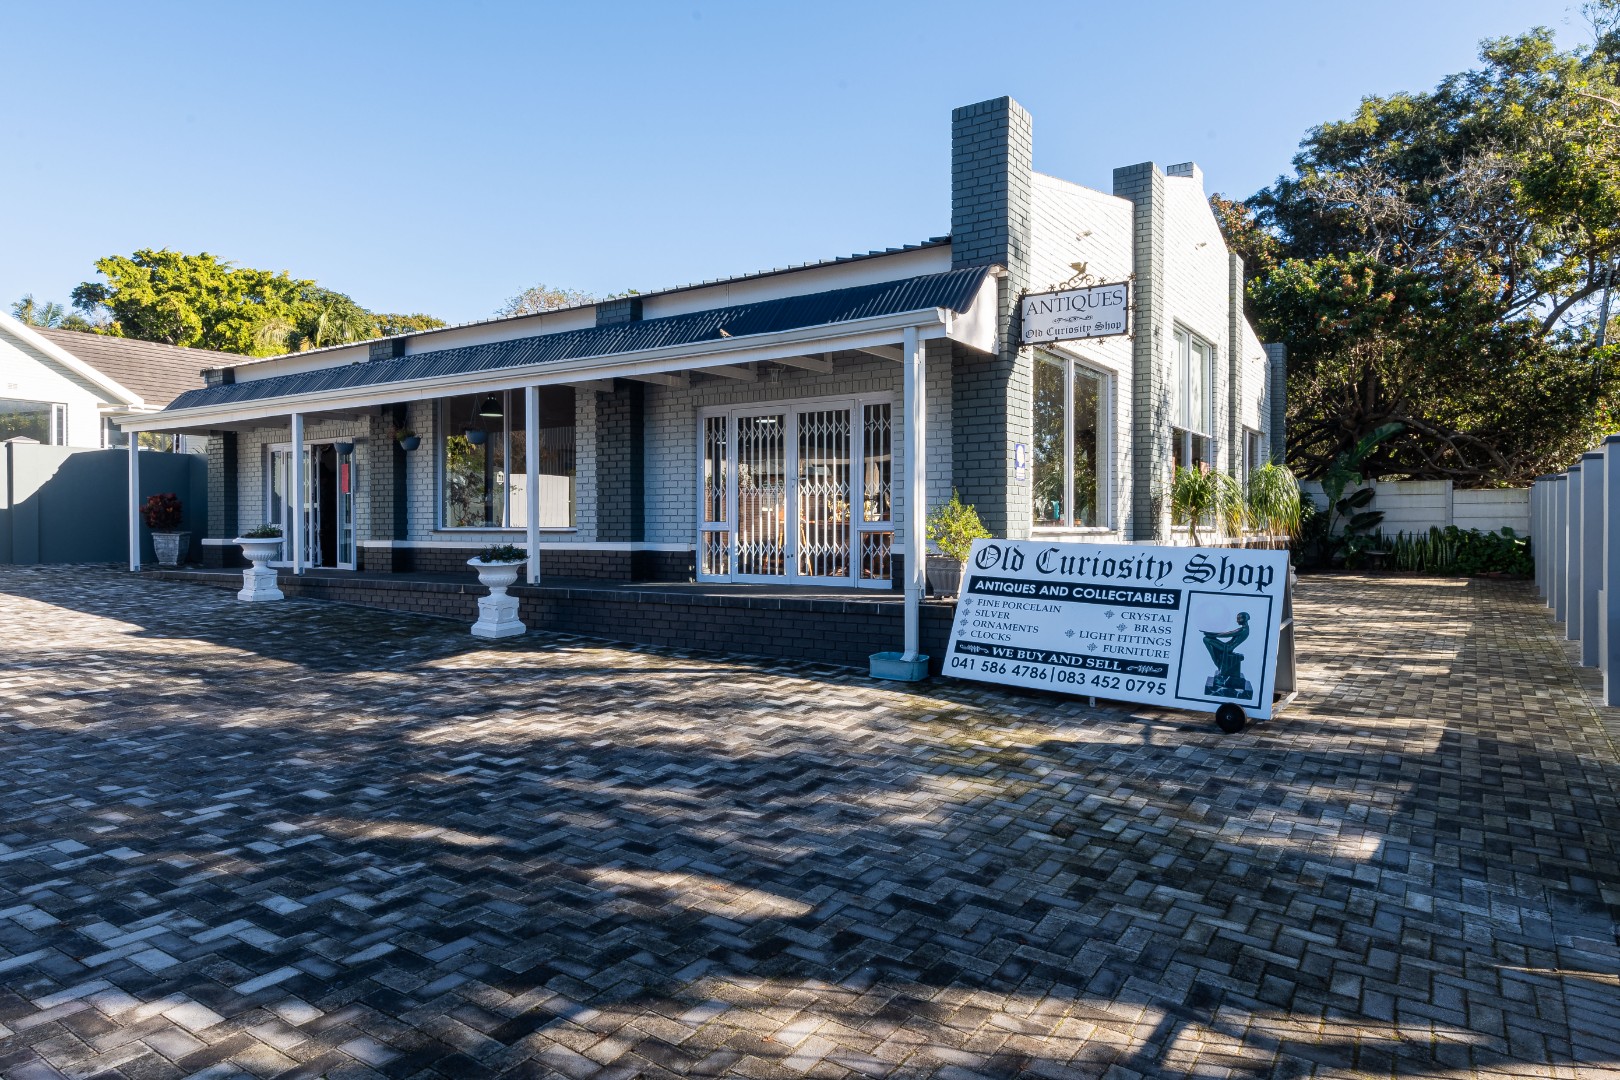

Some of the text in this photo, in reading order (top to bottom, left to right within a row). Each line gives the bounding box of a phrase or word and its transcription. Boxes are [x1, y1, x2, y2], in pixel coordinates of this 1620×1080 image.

[1026, 290, 1123, 315] ANTIQUES
[1025, 321, 1122, 339] Old Curiosity Shop
[975, 544, 1274, 593] Old Curiosity Shop
[975, 580, 1175, 605] ANTIQUES AND COLLECTABLES
[977, 599, 1062, 613] FINE PORCELAIN
[975, 609, 1010, 620] SILVER
[1121, 611, 1173, 623] CRYSTAL
[972, 619, 1039, 633] ORNAMENTS
[1134, 623, 1172, 634] BRASS
[970, 630, 1011, 641] CLOCKS
[1079, 630, 1172, 647] LIGHT FITTINGS
[992, 646, 1122, 671] WE BUY AND SELL
[1102, 645, 1170, 659] FURNITURE
[951, 656, 1166, 695] 041 586 4786 083 452 0795
